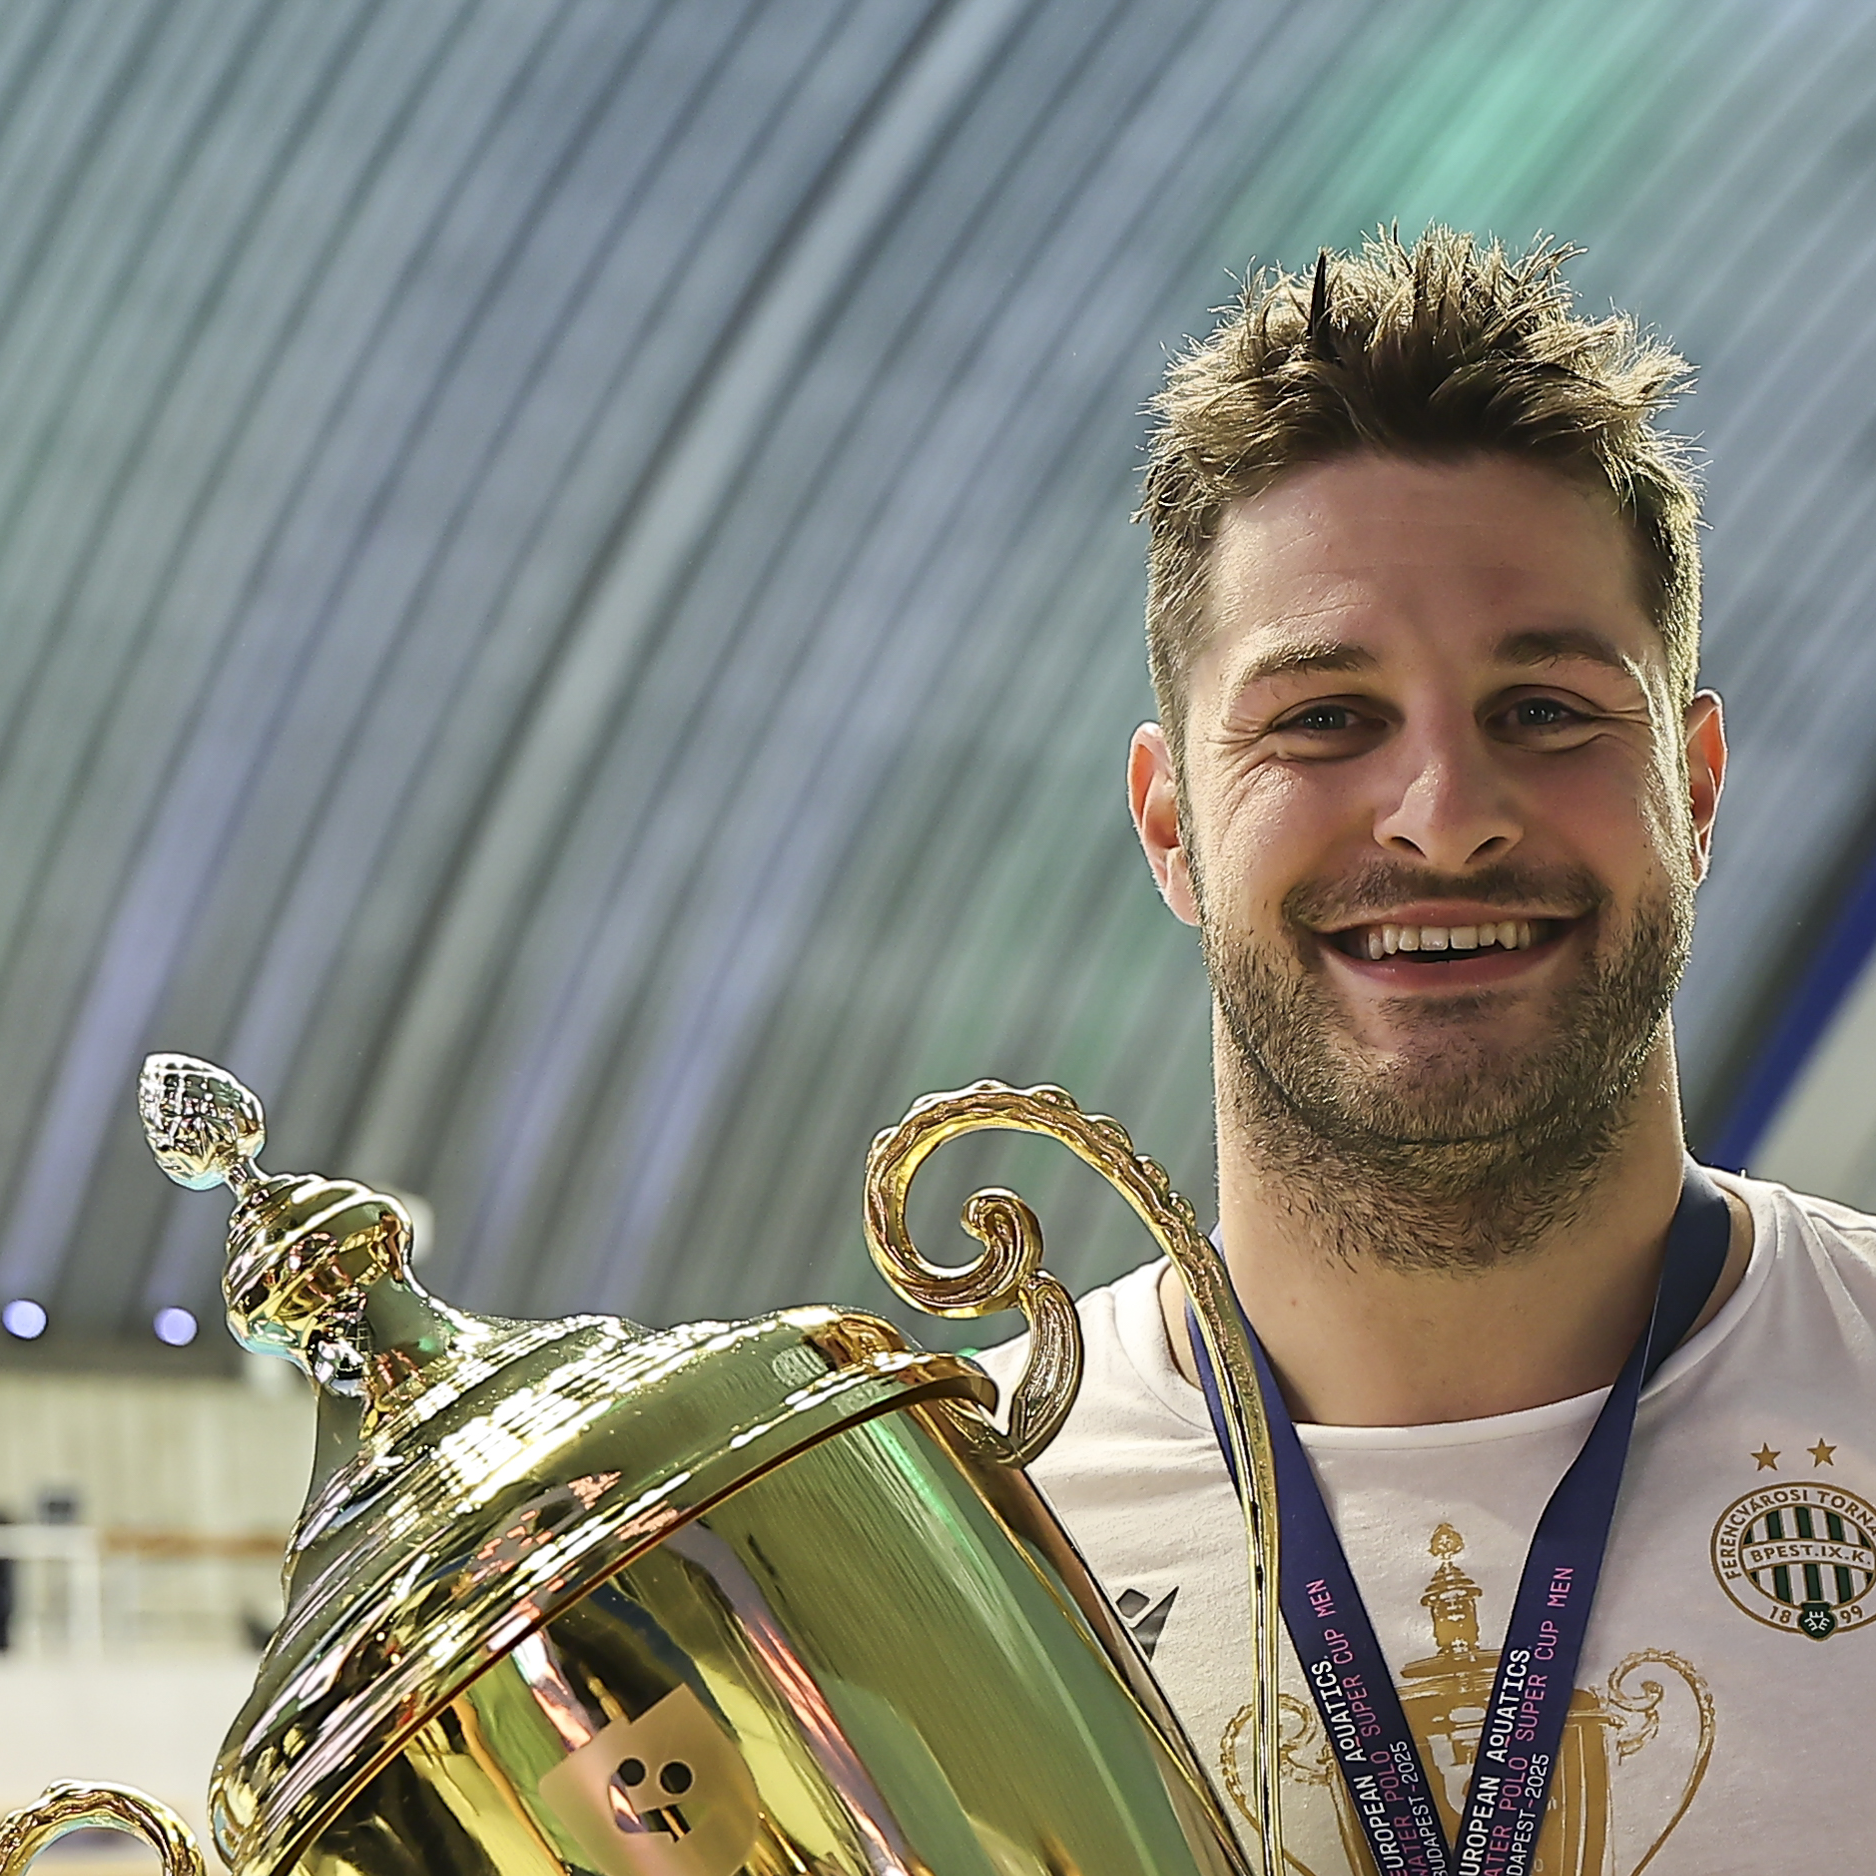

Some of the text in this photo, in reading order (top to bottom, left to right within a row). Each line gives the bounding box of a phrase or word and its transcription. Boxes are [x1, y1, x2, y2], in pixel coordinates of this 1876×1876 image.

[1720, 1489, 1807, 1580] FERENCVÁROSI
[1305, 1578, 1336, 1618] MEN
[1546, 1567, 1574, 1607] MEN
[1324, 1628, 1353, 1665] CUP
[1534, 1620, 1559, 1661] CUP
[1311, 1660, 1367, 1763] AQUATICS
[1342, 1674, 1381, 1738] SUPER
[1486, 1650, 1531, 1763] AQUATICS
[1514, 1674, 1548, 1742] SUPER
[1371, 1750, 1403, 1802] POLO
[1499, 1756, 1528, 1811] POLO
